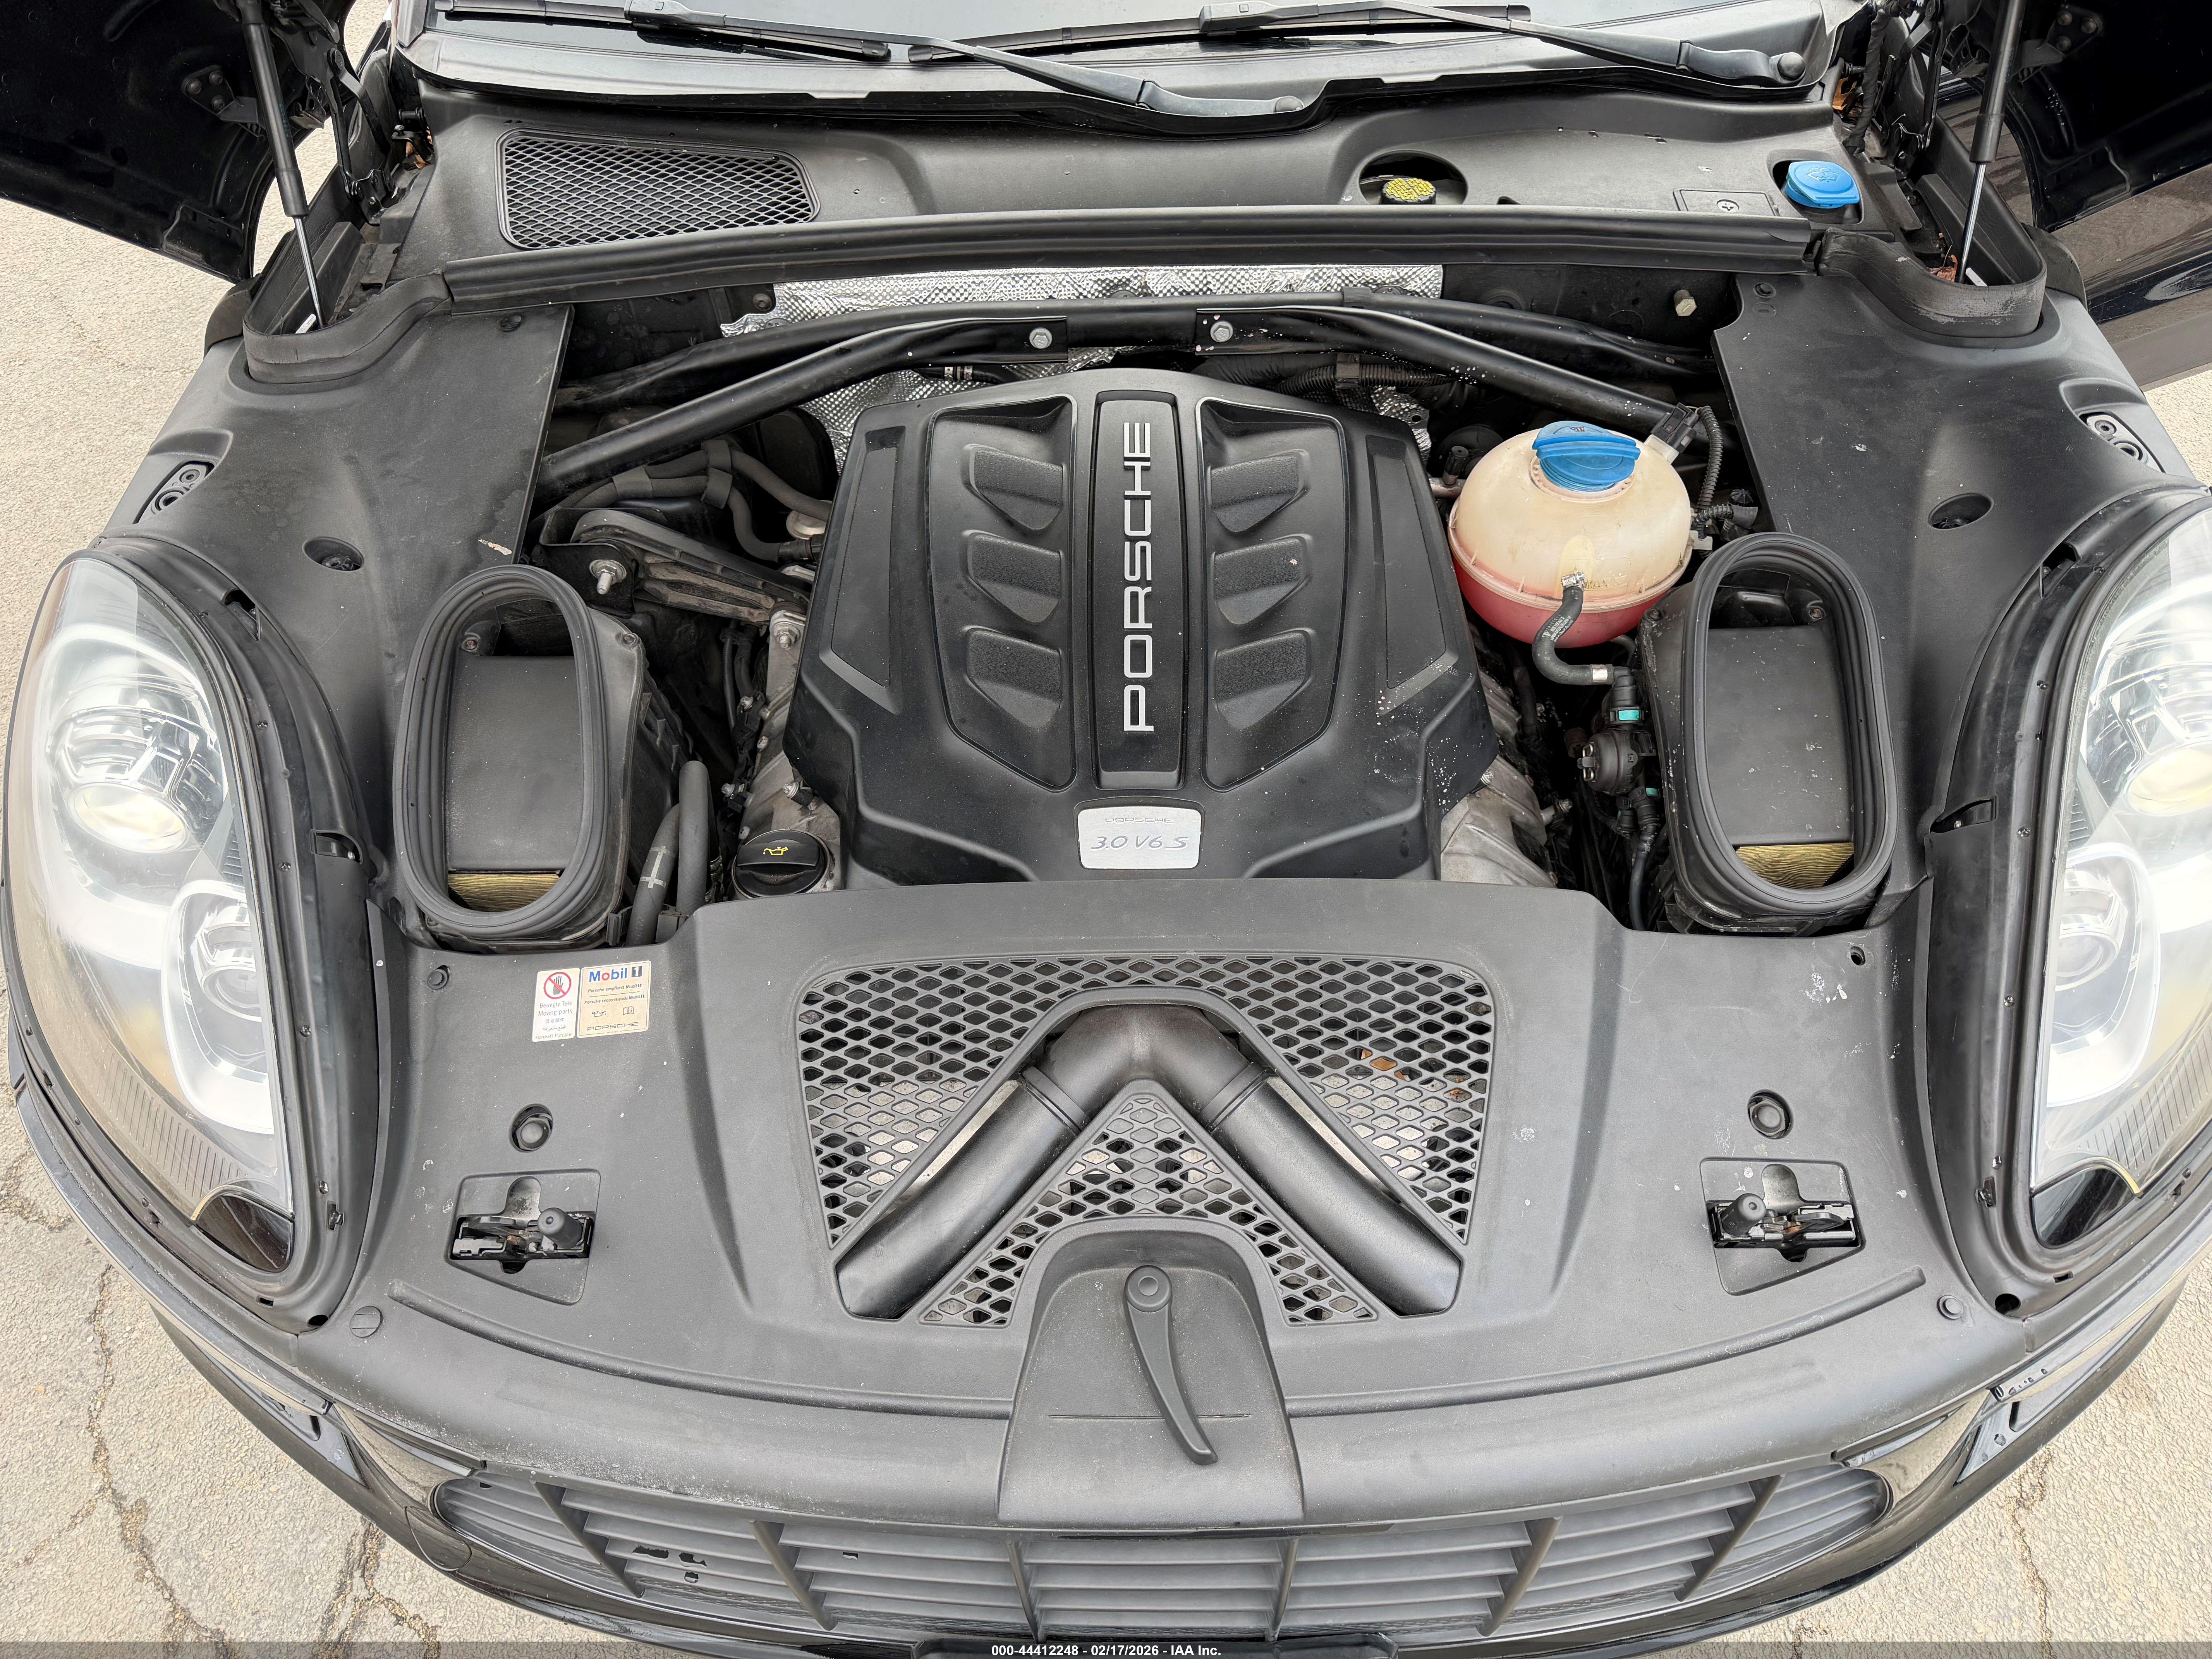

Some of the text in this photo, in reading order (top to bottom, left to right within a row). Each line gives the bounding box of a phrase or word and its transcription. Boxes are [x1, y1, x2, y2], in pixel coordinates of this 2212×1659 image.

[1124, 422, 1154, 732] PORSCHE
[1091, 835, 1190, 851] 3.0 V6 S
[589, 966, 642, 982] Mobil 1
[587, 1022, 638, 1031] PORSCHE
